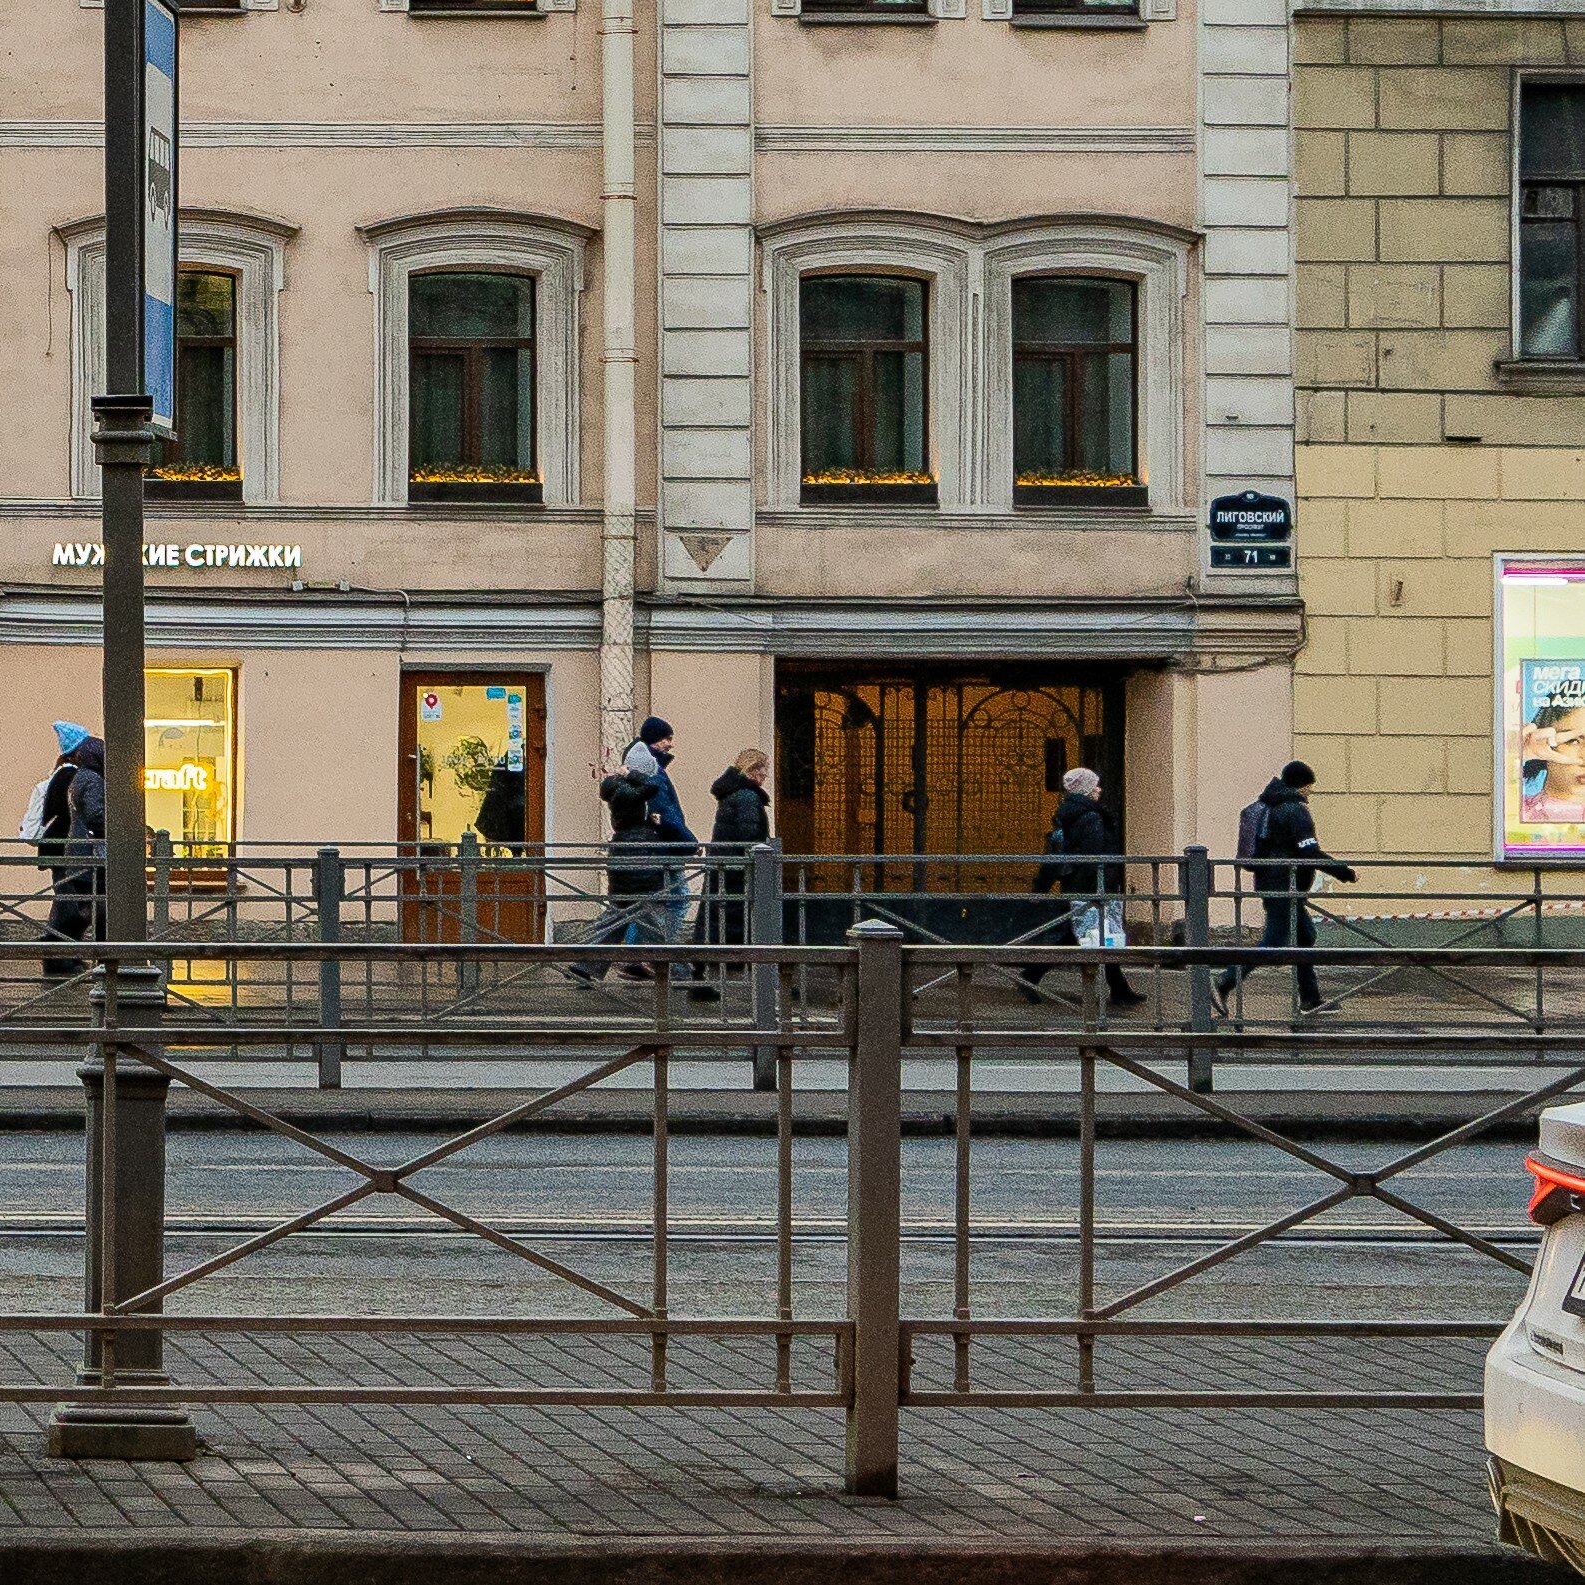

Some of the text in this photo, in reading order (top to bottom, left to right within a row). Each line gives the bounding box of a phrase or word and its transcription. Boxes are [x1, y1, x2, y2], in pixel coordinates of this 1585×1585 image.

[1216, 509, 1285, 523] ЛИГОВСКИЙ
[184, 543, 303, 567] СТРИЖКИ
[1244, 549, 1259, 564] 71
